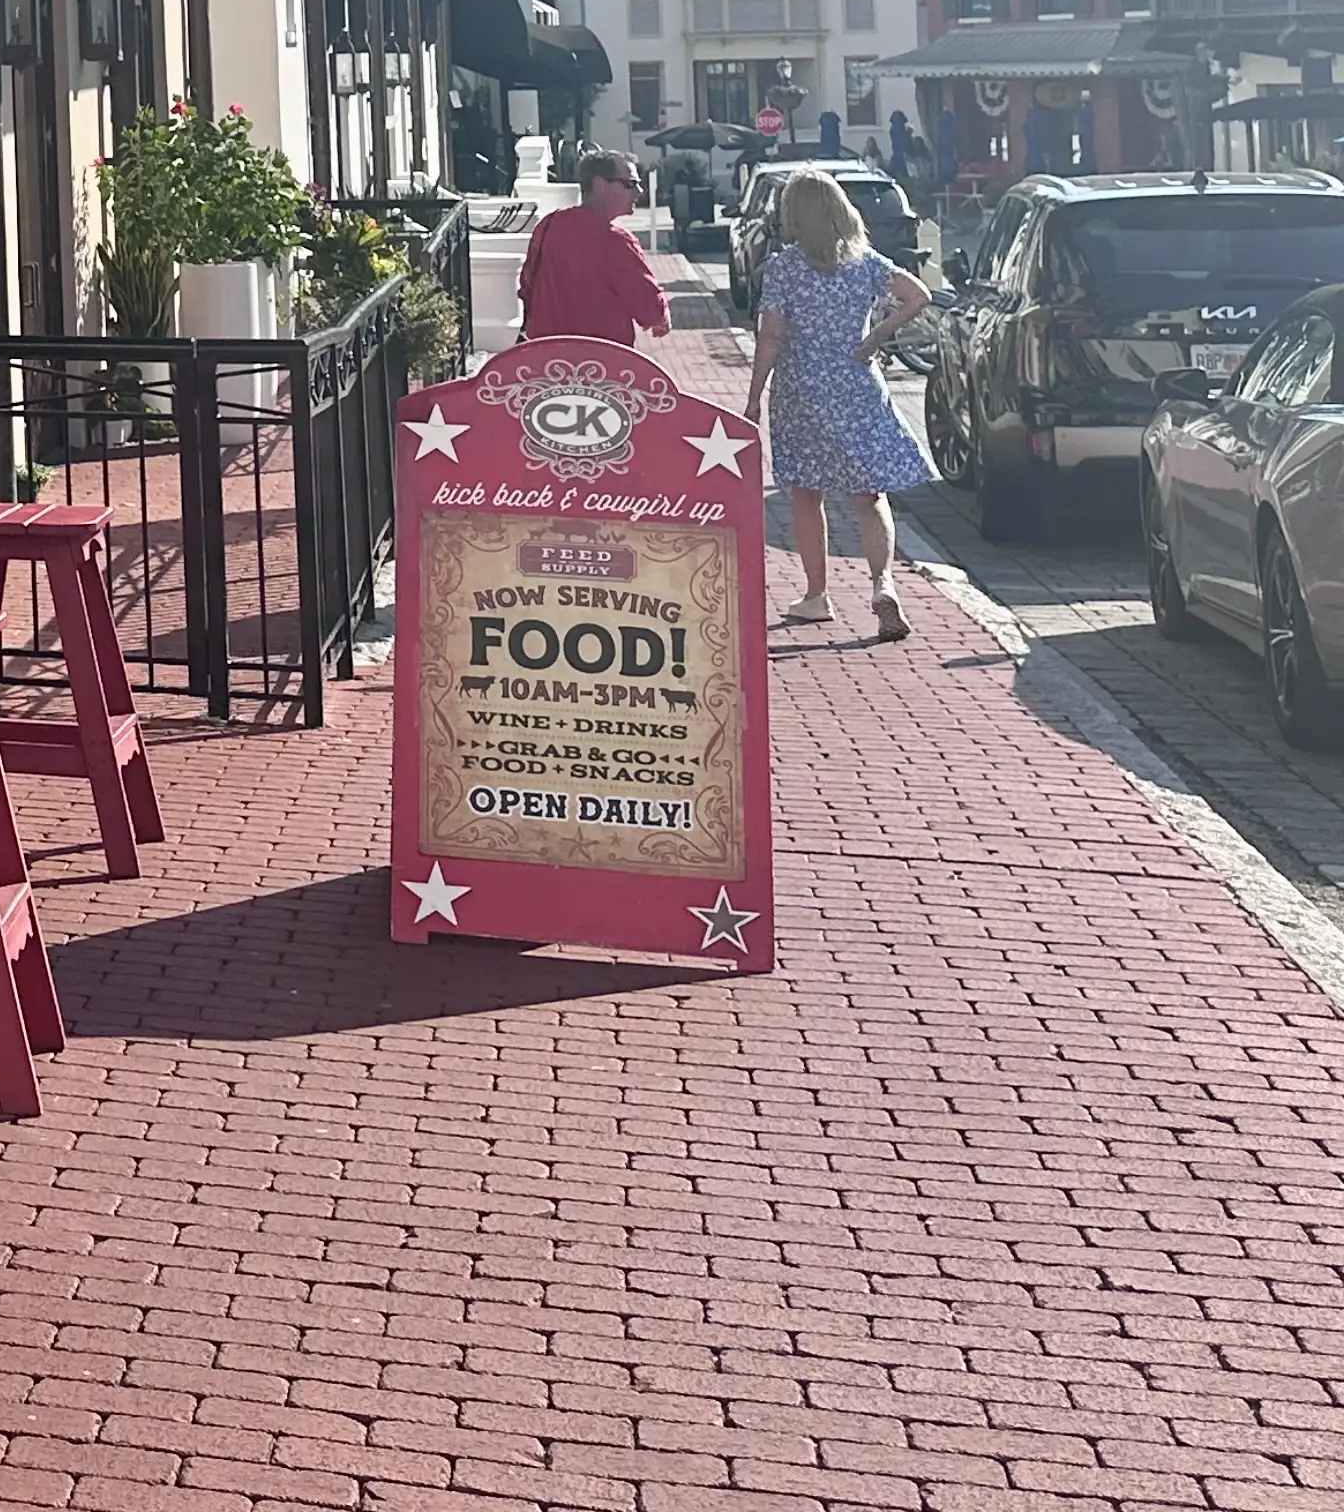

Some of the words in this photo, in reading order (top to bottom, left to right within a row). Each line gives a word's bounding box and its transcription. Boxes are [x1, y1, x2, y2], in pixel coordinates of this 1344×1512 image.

[758, 117, 783, 128] STOP
[1139, 327, 1260, 335] TELLUR
[541, 388, 612, 404] COWGIRL
[537, 403, 611, 437] CK
[541, 437, 612, 453] KITCHEN
[433, 481, 486, 506] kick
[492, 485, 554, 509] back
[560, 487, 578, 511] &
[583, 492, 686, 521] cowgirl
[691, 501, 726, 524] up
[541, 547, 611, 562] FEED
[541, 563, 610, 575] SUPPLY
[473, 586, 545, 612] NOW
[558, 586, 682, 624] SERVING
[469, 616, 687, 679] FOOD!
[499, 676, 656, 709] 10AM-3PM
[467, 710, 550, 730] WINE
[555, 717, 567, 729] +
[573, 718, 688, 740] DRINKS
[497, 741, 581, 761] GRAB
[587, 747, 607, 762] &
[613, 749, 657, 766] GO
[461, 755, 547, 774] FOOD
[551, 763, 565, 774] +
[570, 765, 695, 786] SNACKS
[468, 786, 567, 819] OPEN
[578, 794, 693, 829] DAILY!
